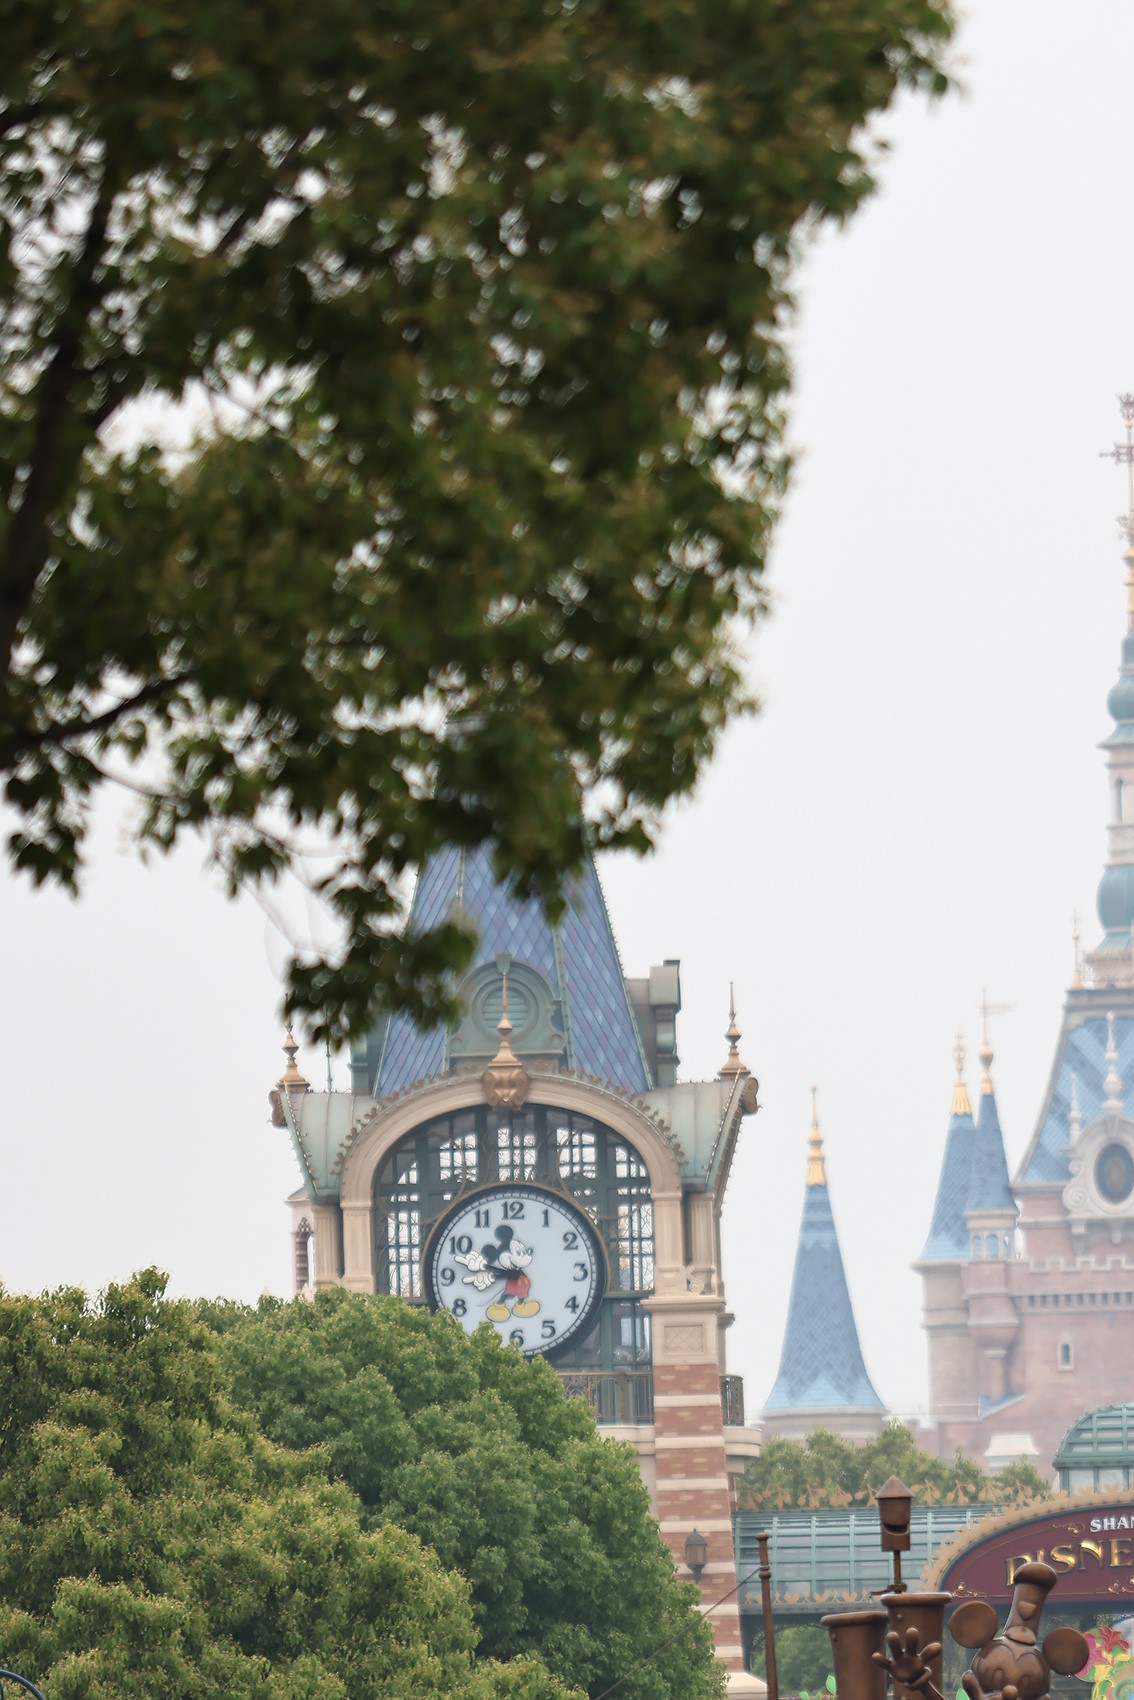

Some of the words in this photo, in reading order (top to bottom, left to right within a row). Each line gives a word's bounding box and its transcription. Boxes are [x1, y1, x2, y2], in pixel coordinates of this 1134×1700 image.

[473, 1209, 490, 1229] 11
[500, 1200, 525, 1221] 12
[541, 1208, 551, 1228] 1
[449, 1235, 473, 1255] 10
[562, 1232, 579, 1251] 2
[440, 1267, 456, 1287] 9
[573, 1263, 589, 1281] 3
[452, 1298, 467, 1318] 8
[564, 1295, 580, 1314] 4
[509, 1329, 525, 1348] 6
[541, 1320, 557, 1339] 5
